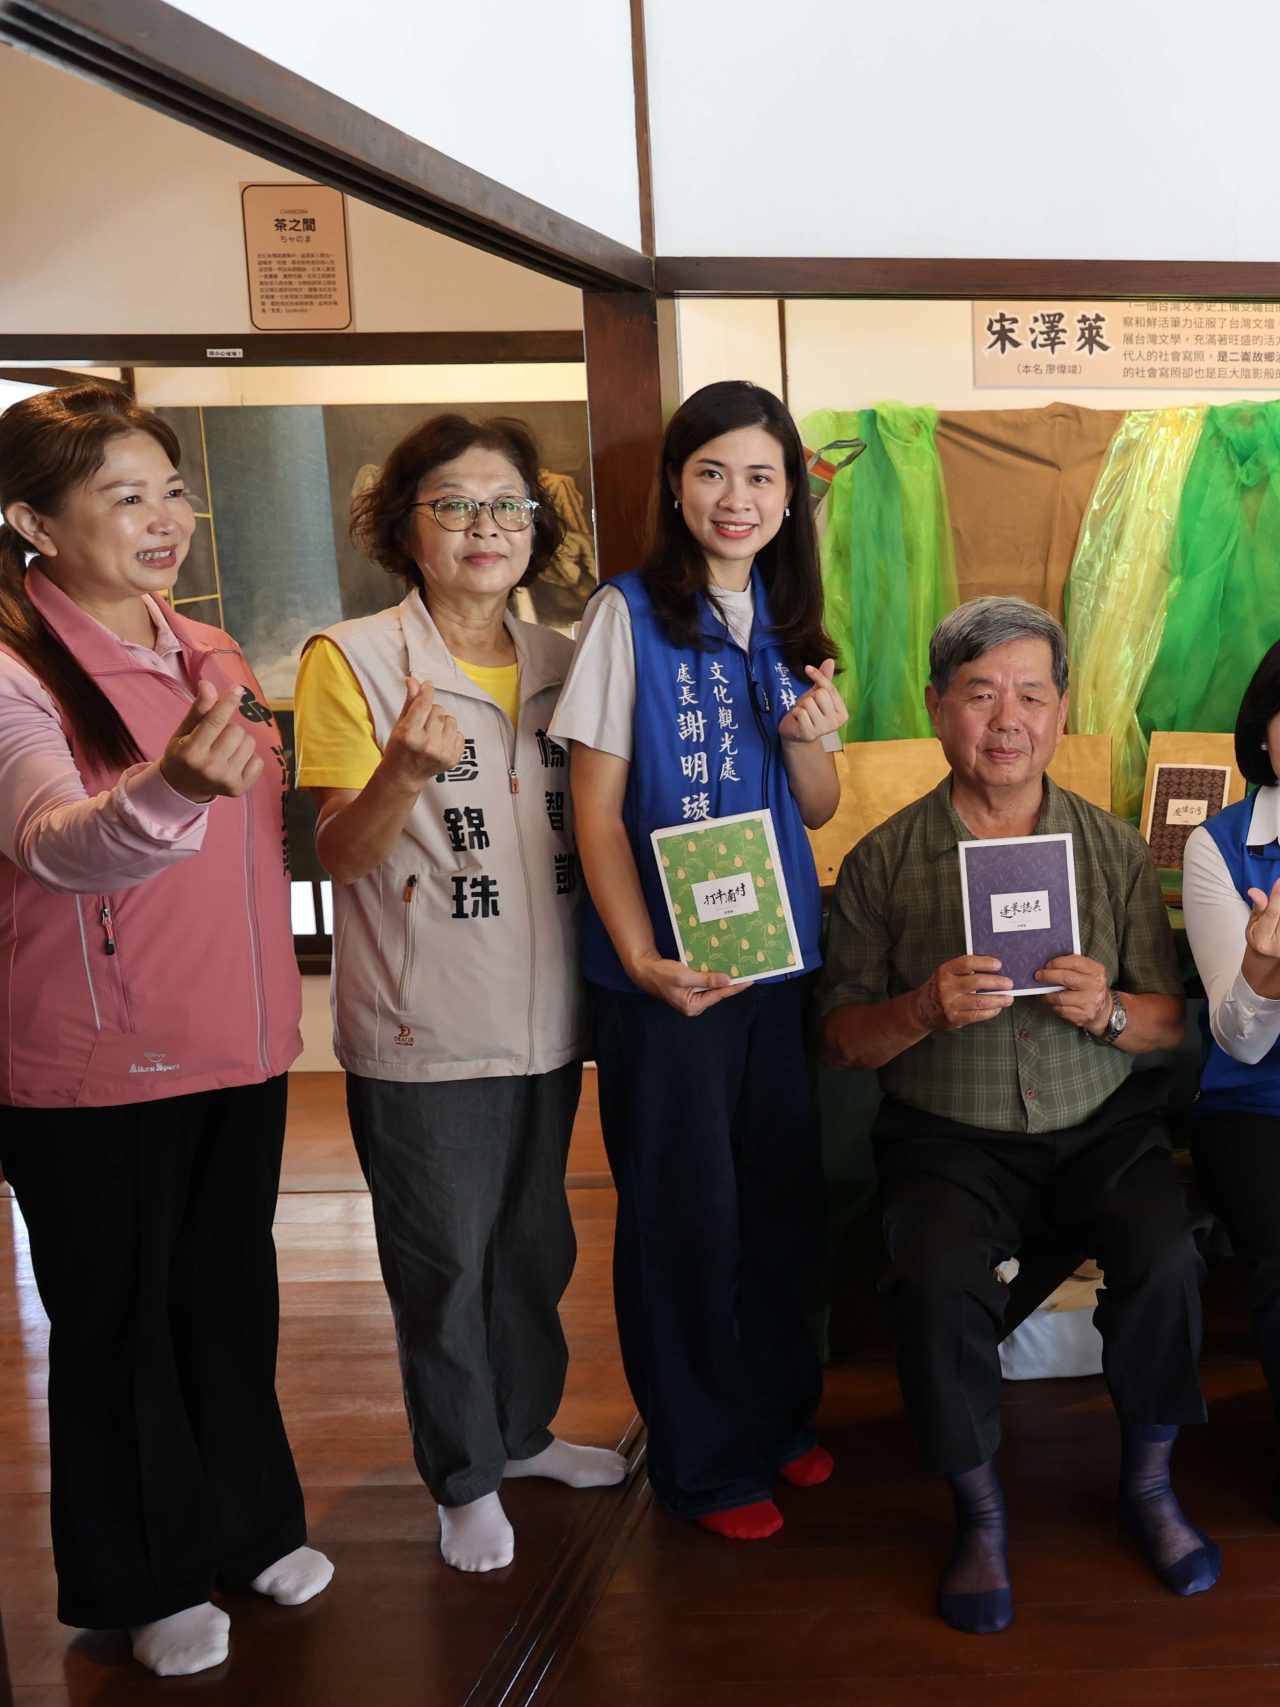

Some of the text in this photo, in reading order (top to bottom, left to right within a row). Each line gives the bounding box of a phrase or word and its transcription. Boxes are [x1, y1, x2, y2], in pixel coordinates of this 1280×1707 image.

[273, 217, 316, 232] 茶之間
[986, 311, 1112, 356] 宋澤萊
[708, 661, 741, 782] 文化觀光處
